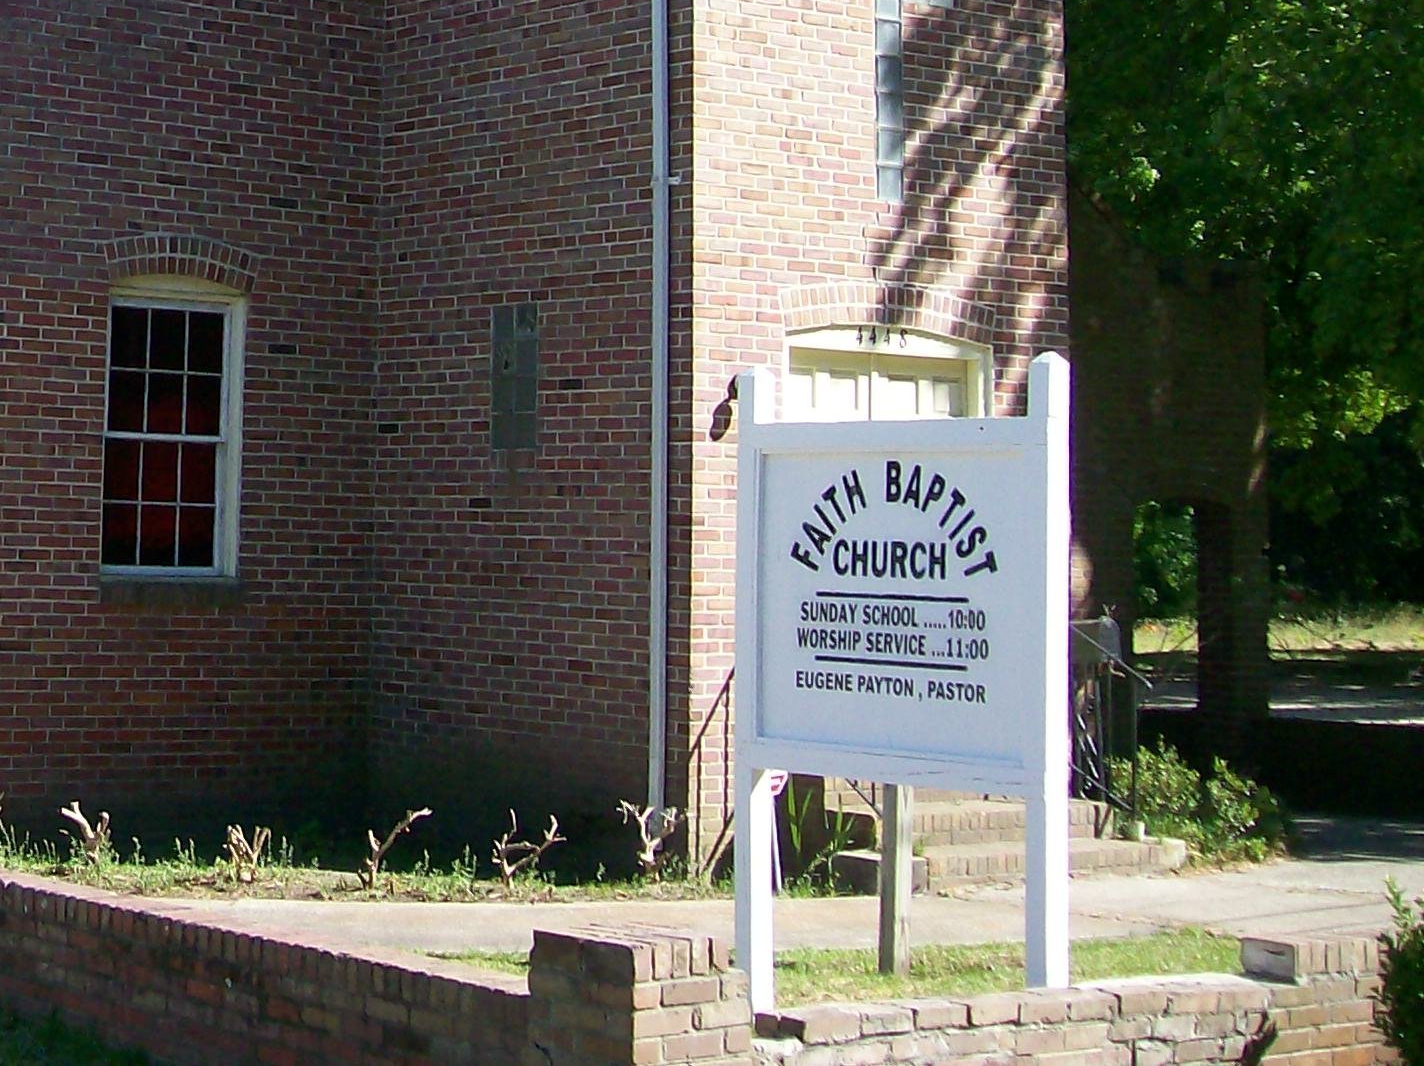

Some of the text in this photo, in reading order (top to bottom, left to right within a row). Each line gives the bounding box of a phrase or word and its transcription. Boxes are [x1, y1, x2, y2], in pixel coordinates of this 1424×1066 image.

[855, 326, 909, 348] 4448
[790, 460, 998, 577] FAITH BAPTIST
[832, 539, 947, 580] CHURCH
[800, 601, 858, 624] SUNDAY
[862, 604, 918, 628] SCHOOL
[797, 627, 862, 652] WORSHIP
[865, 632, 927, 657] SERVICE
[795, 670, 853, 692] EUGENE
[927, 680, 986, 704] PASTOR
